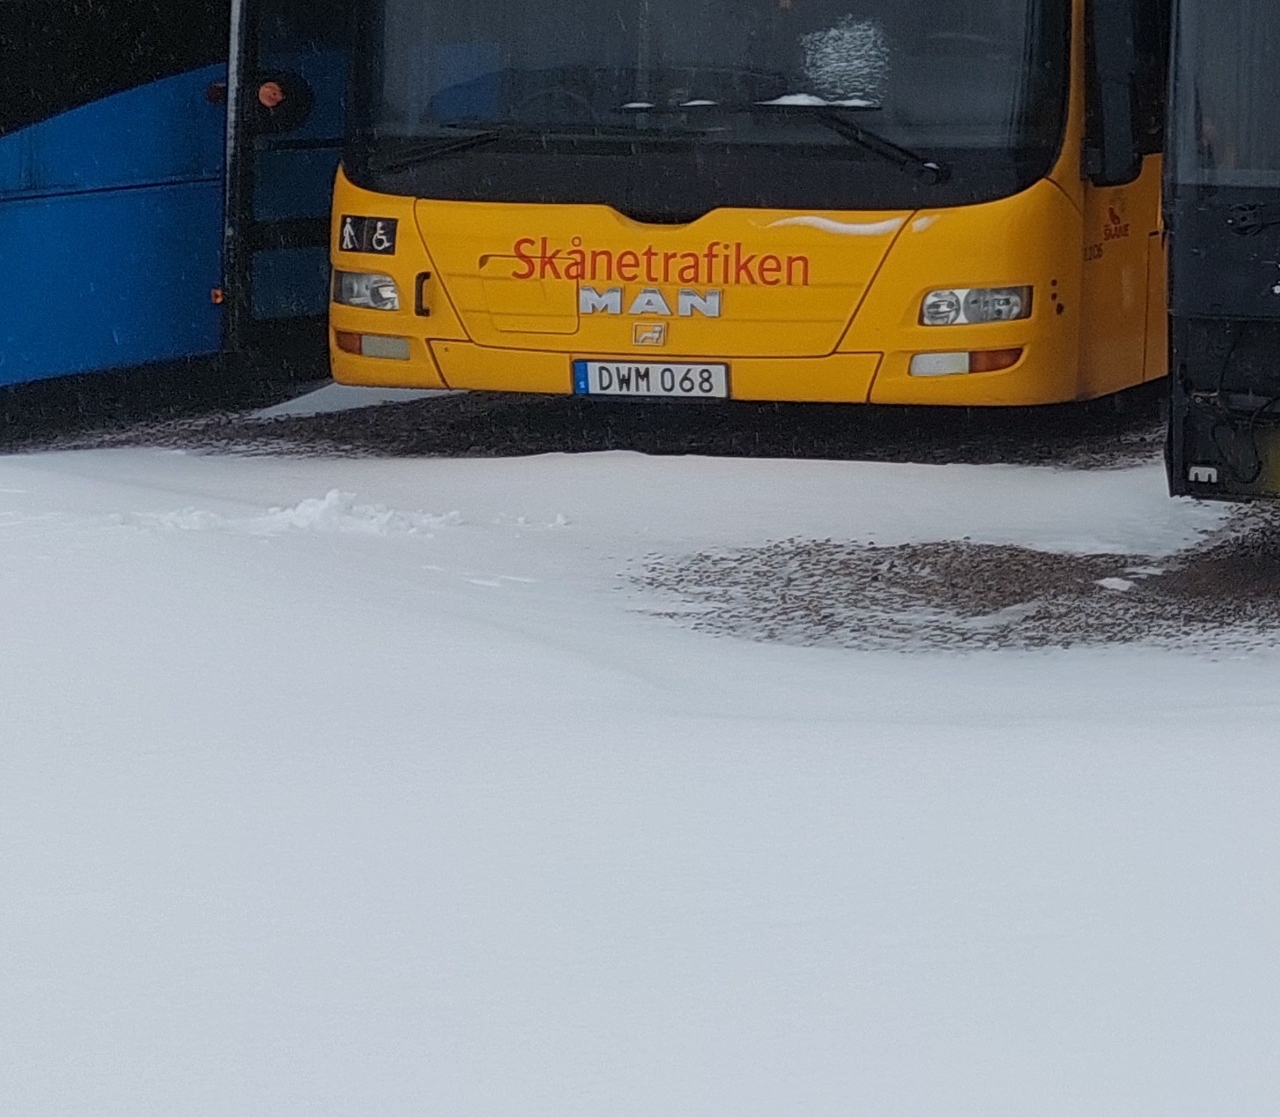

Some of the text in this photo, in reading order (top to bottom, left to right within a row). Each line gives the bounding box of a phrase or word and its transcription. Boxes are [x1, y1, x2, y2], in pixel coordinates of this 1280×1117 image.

[511, 235, 810, 286] Skånetrafiken
[579, 285, 722, 318] MAN
[598, 365, 651, 392] DWM
[660, 367, 714, 394] 068
